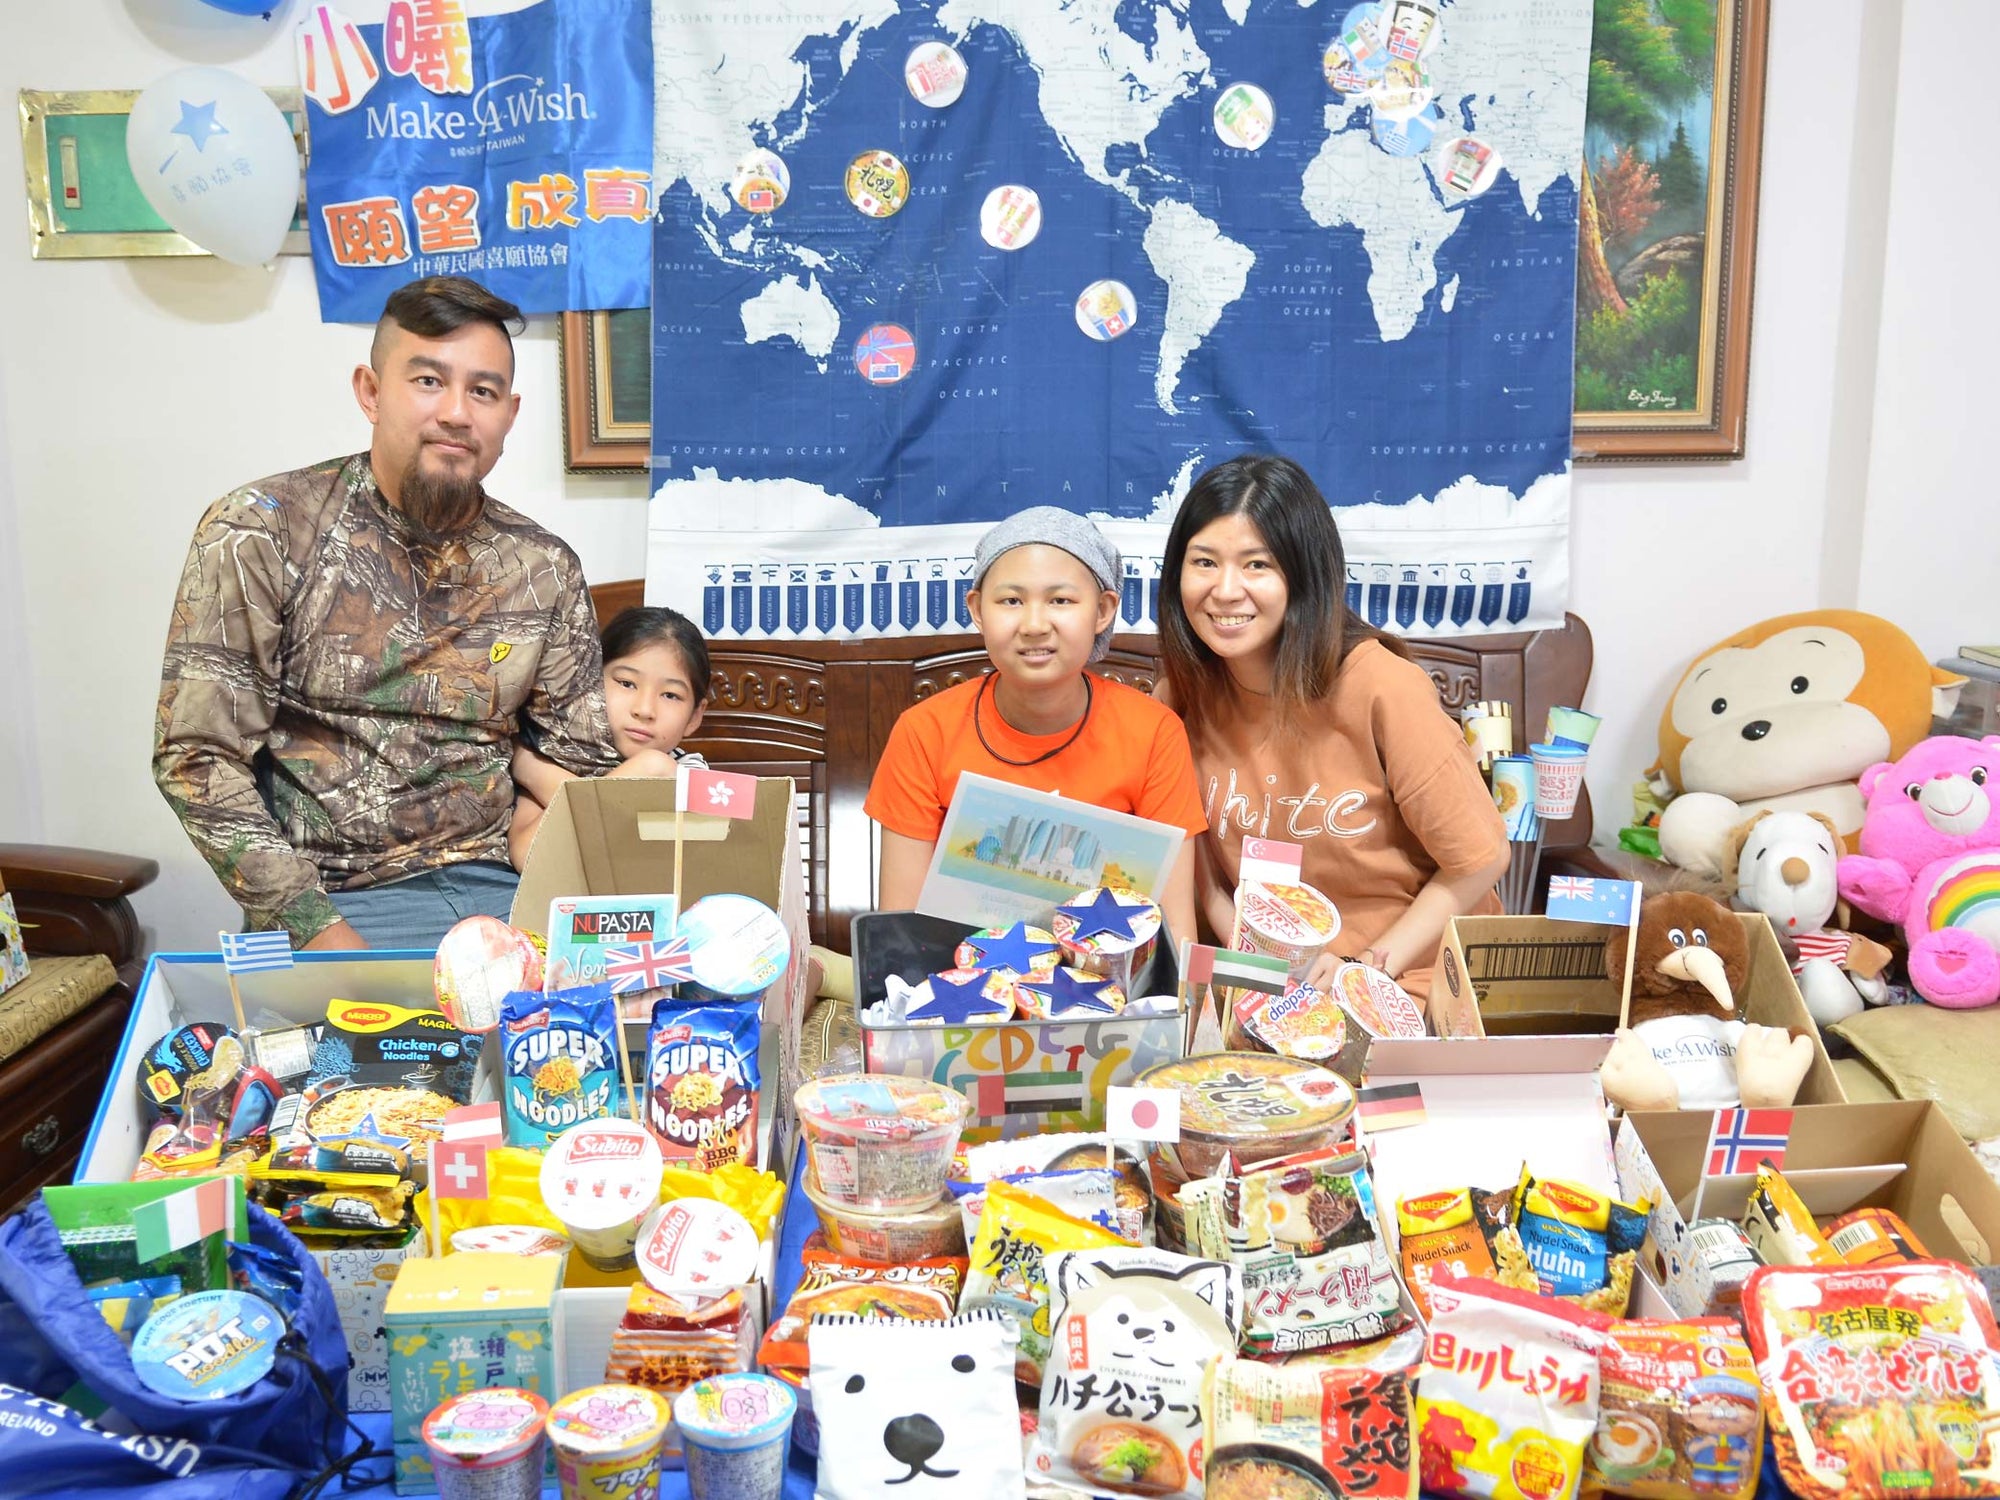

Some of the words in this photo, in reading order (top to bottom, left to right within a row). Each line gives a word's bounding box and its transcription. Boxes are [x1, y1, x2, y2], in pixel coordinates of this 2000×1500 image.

[900, 120, 947, 130] NORTH
[485, 135, 526, 151] TAIWAN
[903, 152, 953, 163] ACIFIC
[1213, 148, 1260, 159] OCEAN
[910, 185, 948, 196] CEAN
[324, 187, 479, 265] 願望
[509, 170, 652, 230] 成真
[413, 243, 569, 278] 中華民國喜願協會
[658, 262, 704, 271] INDIAN
[1283, 264, 1333, 274] SOUTH
[1490, 257, 1563, 269] INDIAN
[1271, 285, 1344, 296] ATLANTIC
[1283, 307, 1332, 317] OCEAN
[660, 324, 701, 334] OCEAN
[941, 325, 998, 336] SOUTH
[1493, 331, 1556, 342] OCEAN
[931, 355, 1008, 368] PACIFIC
[939, 387, 998, 400] OCEAN
[671, 446, 770, 456] SOUTHERN
[786, 445, 847, 456] OCEAN
[1370, 445, 1470, 455] SOUTHERN
[1485, 442, 1547, 453] OCEAN
[1539, 775, 1577, 791] BEST
[1207, 769, 1377, 840] hite
[573, 913, 653, 934] NUPASTA
[1268, 981, 1315, 1021] Sedaap
[346, 1012, 387, 1021] Maggi
[181, 1031, 210, 1067] CHICKEN
[379, 1039, 438, 1052] Chicken
[513, 1029, 606, 1075] SUPER
[1652, 1046, 1672, 1061] ke
[383, 1052, 430, 1061] Noodles
[652, 1044, 745, 1086] SUPER
[513, 1077, 610, 1127] NOODLES
[651, 1093, 750, 1143] NOODLES
[573, 1134, 640, 1157] Subito
[705, 1145, 738, 1161] BBQ
[1408, 1197, 1456, 1212] Maggi
[1546, 1185, 1592, 1209] Maggi
[648, 1209, 687, 1266] Subito
[1529, 1230, 1560, 1248] Nudel
[1561, 1238, 1592, 1256] Snack
[1411, 1246, 1441, 1264] Nudel
[1441, 1241, 1472, 1257] Snack
[1527, 1241, 1586, 1279] Huhn
[1248, 1264, 1393, 1319] 一蘭ラーメン
[1816, 1306, 1921, 1339] 名古屋発
[187, 1337, 256, 1381] noodle
[448, 1336, 481, 1390] 塩レモ
[479, 1336, 506, 1386] 瀬戸
[1706, 1348, 1724, 1366] 4
[1779, 1343, 1985, 1406] 台湾まぜそば
[1335, 1386, 1379, 1491] ラーメン
